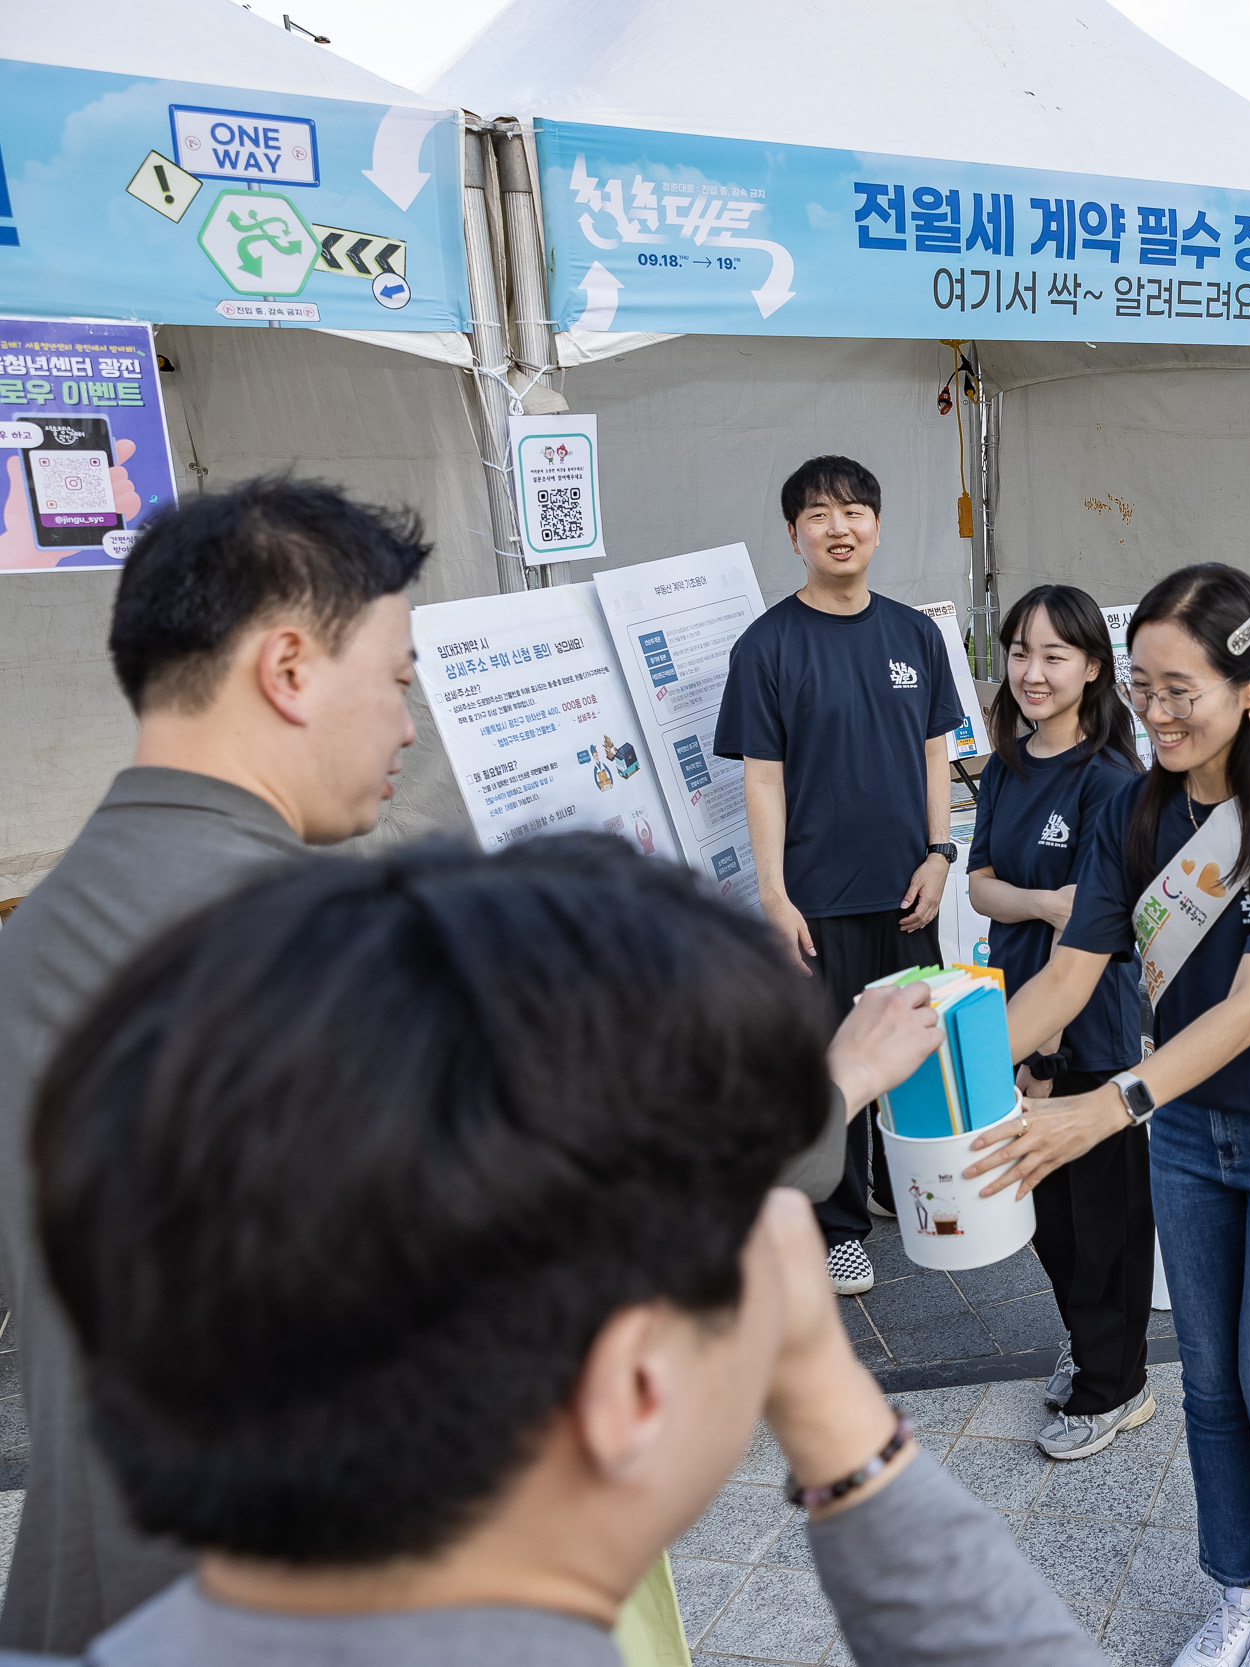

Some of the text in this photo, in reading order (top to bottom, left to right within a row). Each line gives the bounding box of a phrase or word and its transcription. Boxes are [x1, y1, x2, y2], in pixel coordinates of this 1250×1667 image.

[210, 122, 282, 151] ONE
[212, 148, 282, 174] WAY
[662, 182, 695, 193] 청춘대로
[701, 184, 718, 195] 진입
[732, 187, 748, 197] 감속
[750, 189, 766, 199] 금지
[853, 181, 1014, 257] 전월세
[1030, 197, 1126, 263] 계약
[1137, 206, 1221, 270] 필수
[637, 253, 682, 268] 09.18.
[716, 257, 736, 270] 19.
[933, 267, 1037, 314] 여기서
[1047, 272, 1103, 315] 싹~
[236, 306, 253, 315] 진입
[268, 307, 285, 316] 감속
[286, 308, 303, 317] 금지
[0, 341, 22, 349] 금해?
[0, 356, 142, 379] 청년센터 광진
[0, 379, 145, 406] 로우 이벤트
[12, 431, 32, 440] 하고
[55, 514, 104, 525] @jingu_syc
[110, 535, 138, 545] 간편식
[654, 575, 708, 596] 부동산 계약 기초용어
[920, 605, 955, 618] 지점번호판
[437, 637, 490, 659] 임대차계약 시
[445, 658, 488, 680] 상세주소
[489, 652, 511, 669] 부여
[512, 647, 532, 665] 신청
[533, 643, 553, 660] 동의
[444, 684, 481, 702] 상세주소란?
